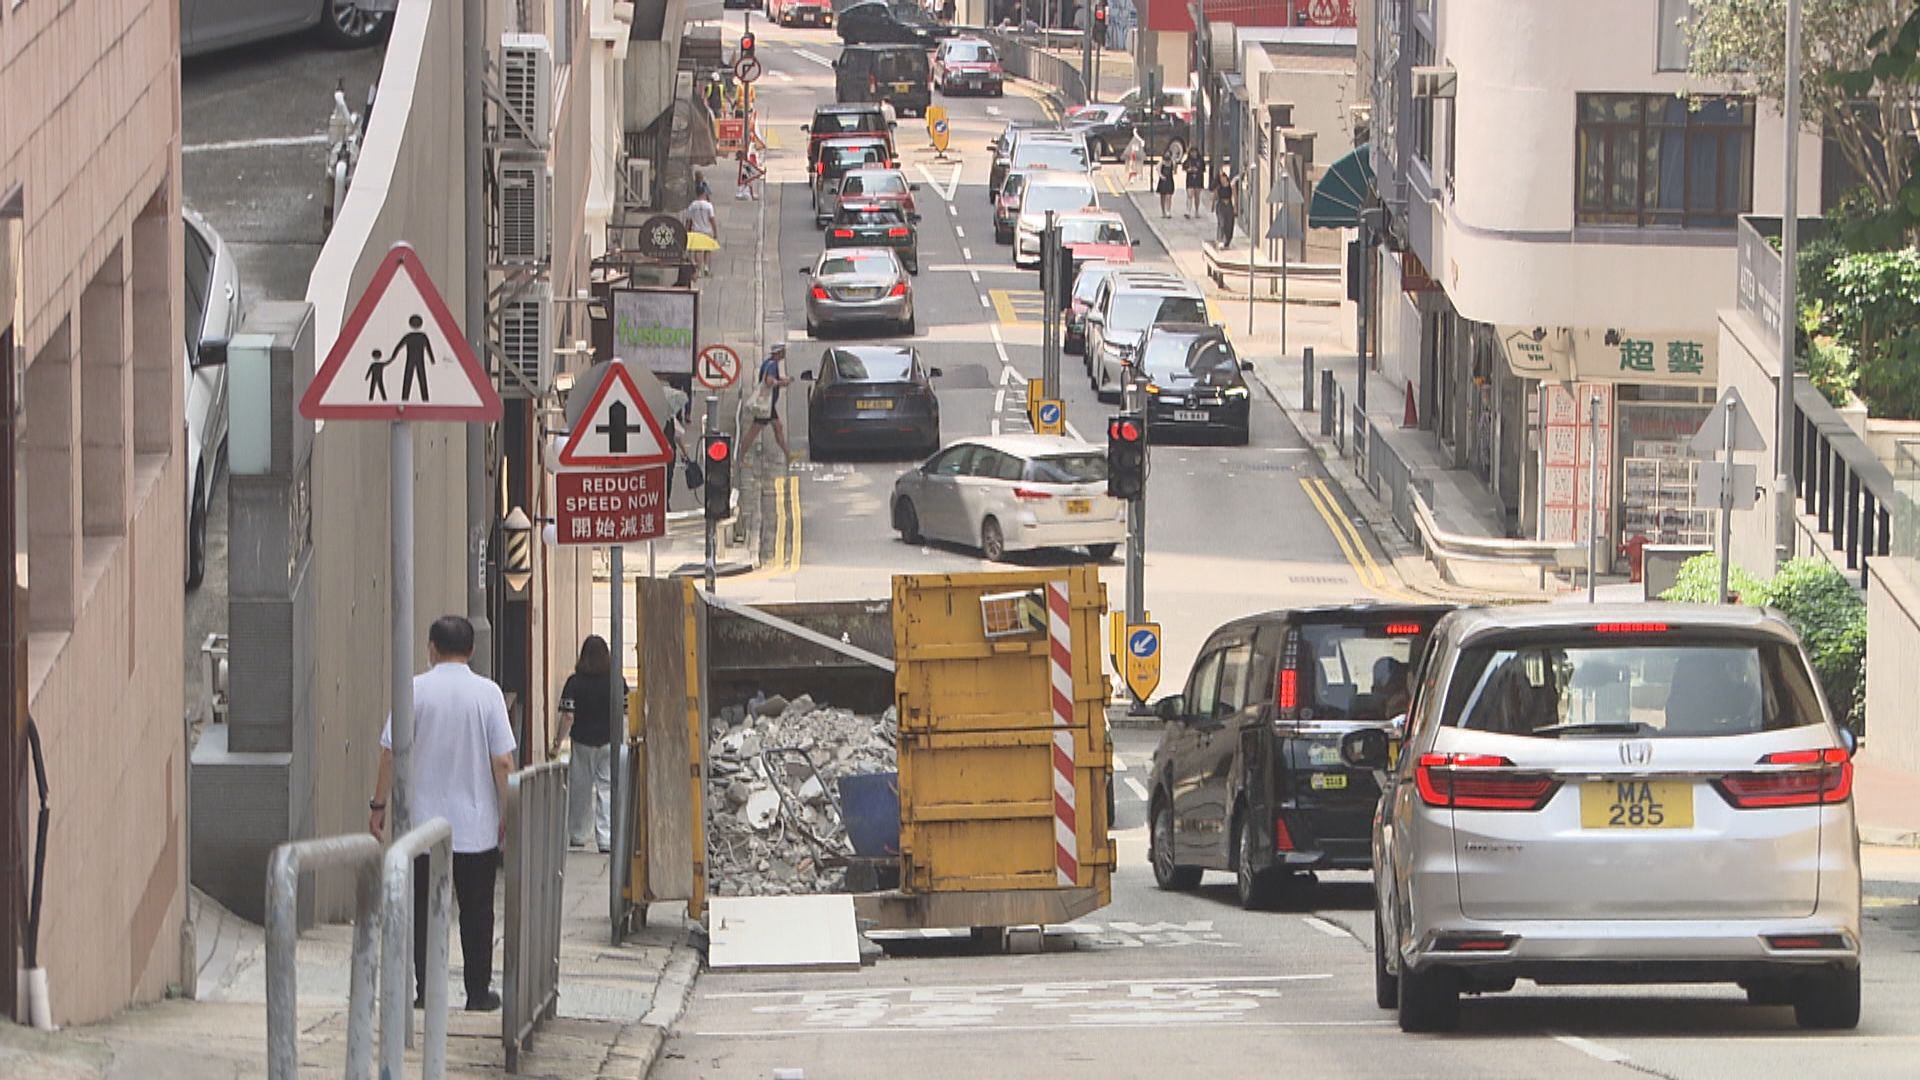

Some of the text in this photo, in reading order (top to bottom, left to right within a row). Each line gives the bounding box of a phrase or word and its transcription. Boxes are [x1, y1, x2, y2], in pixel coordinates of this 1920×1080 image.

[618, 315, 691, 345] fusion
[1619, 338, 1704, 374] 超藝
[582, 475, 647, 493] REDUCE
[566, 491, 659, 512] SPEED NOW
[571, 513, 655, 539] 開始減速
[1617, 781, 1654, 803] MA
[1608, 803, 1664, 826] 285
